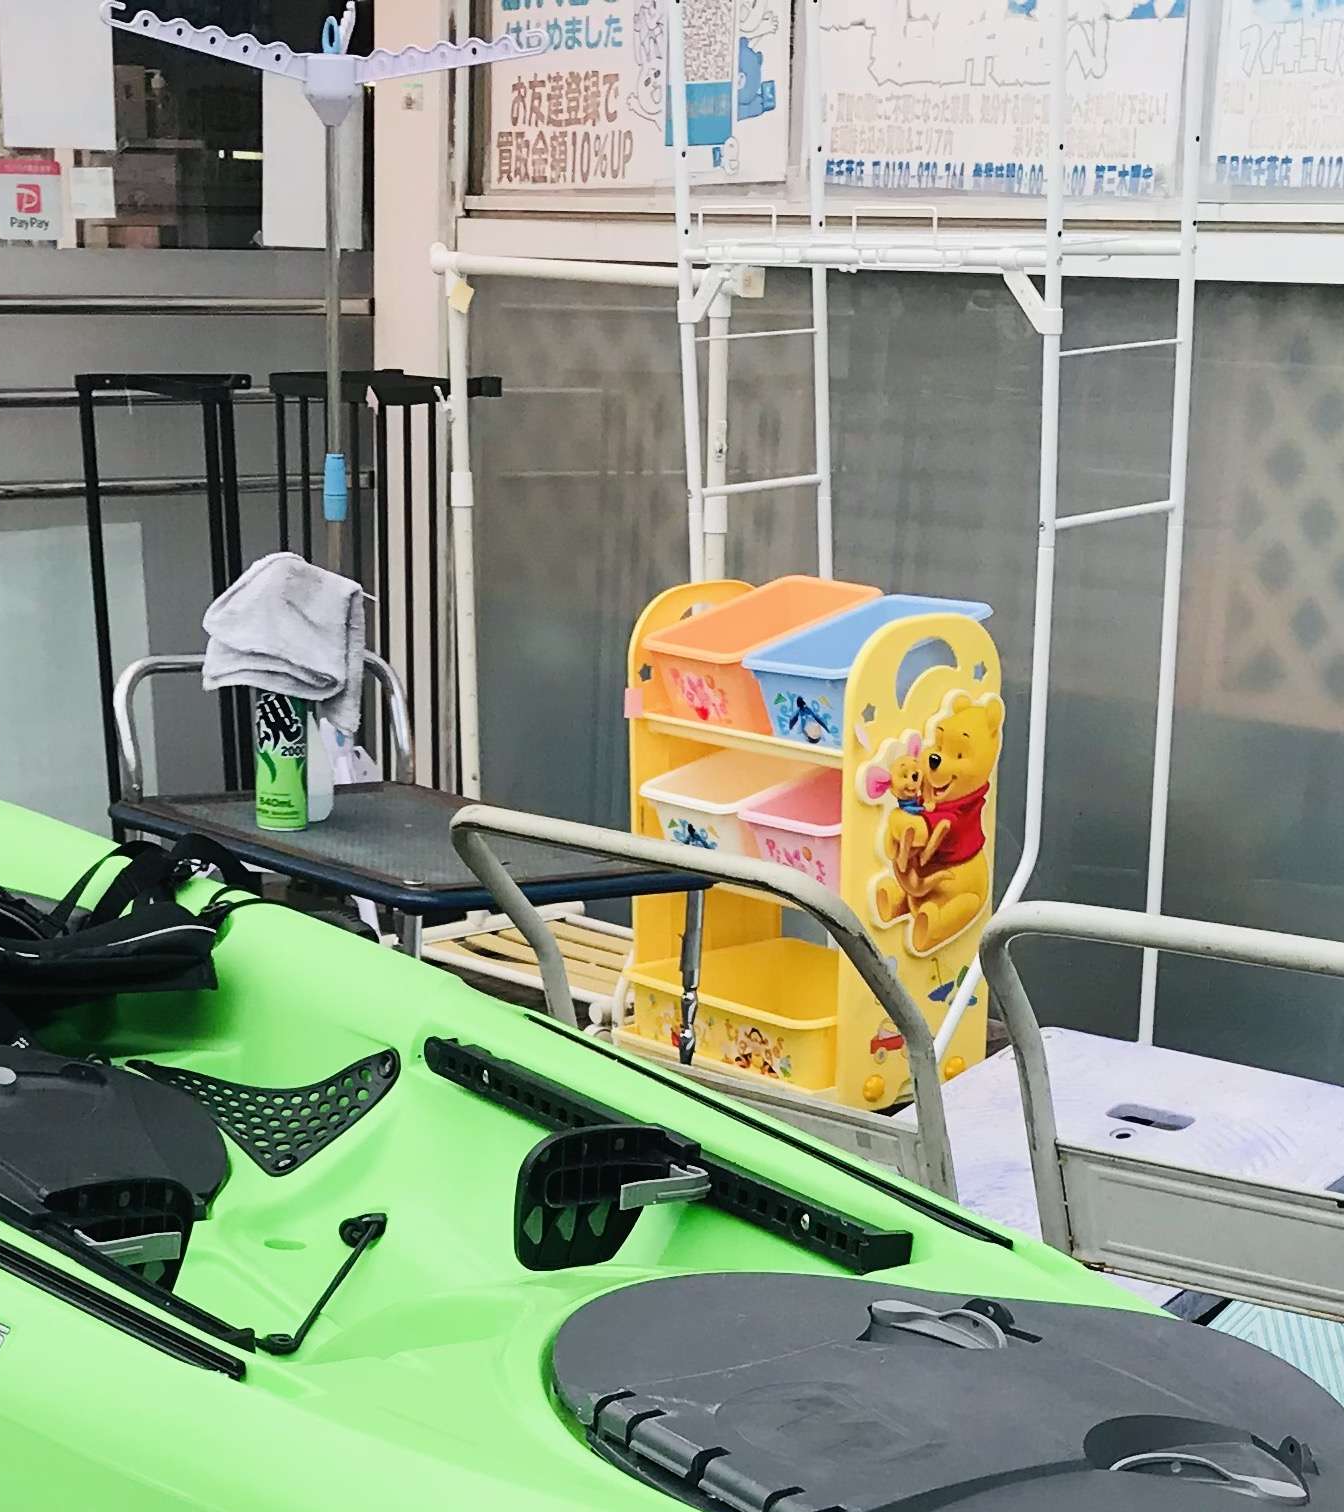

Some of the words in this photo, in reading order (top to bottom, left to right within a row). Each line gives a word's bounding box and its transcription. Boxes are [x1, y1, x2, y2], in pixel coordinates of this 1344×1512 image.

[510, 71, 620, 127] お友達登録で
[496, 130, 634, 184] 買取金額10%UP
[10, 216, 49, 231] PayPay
